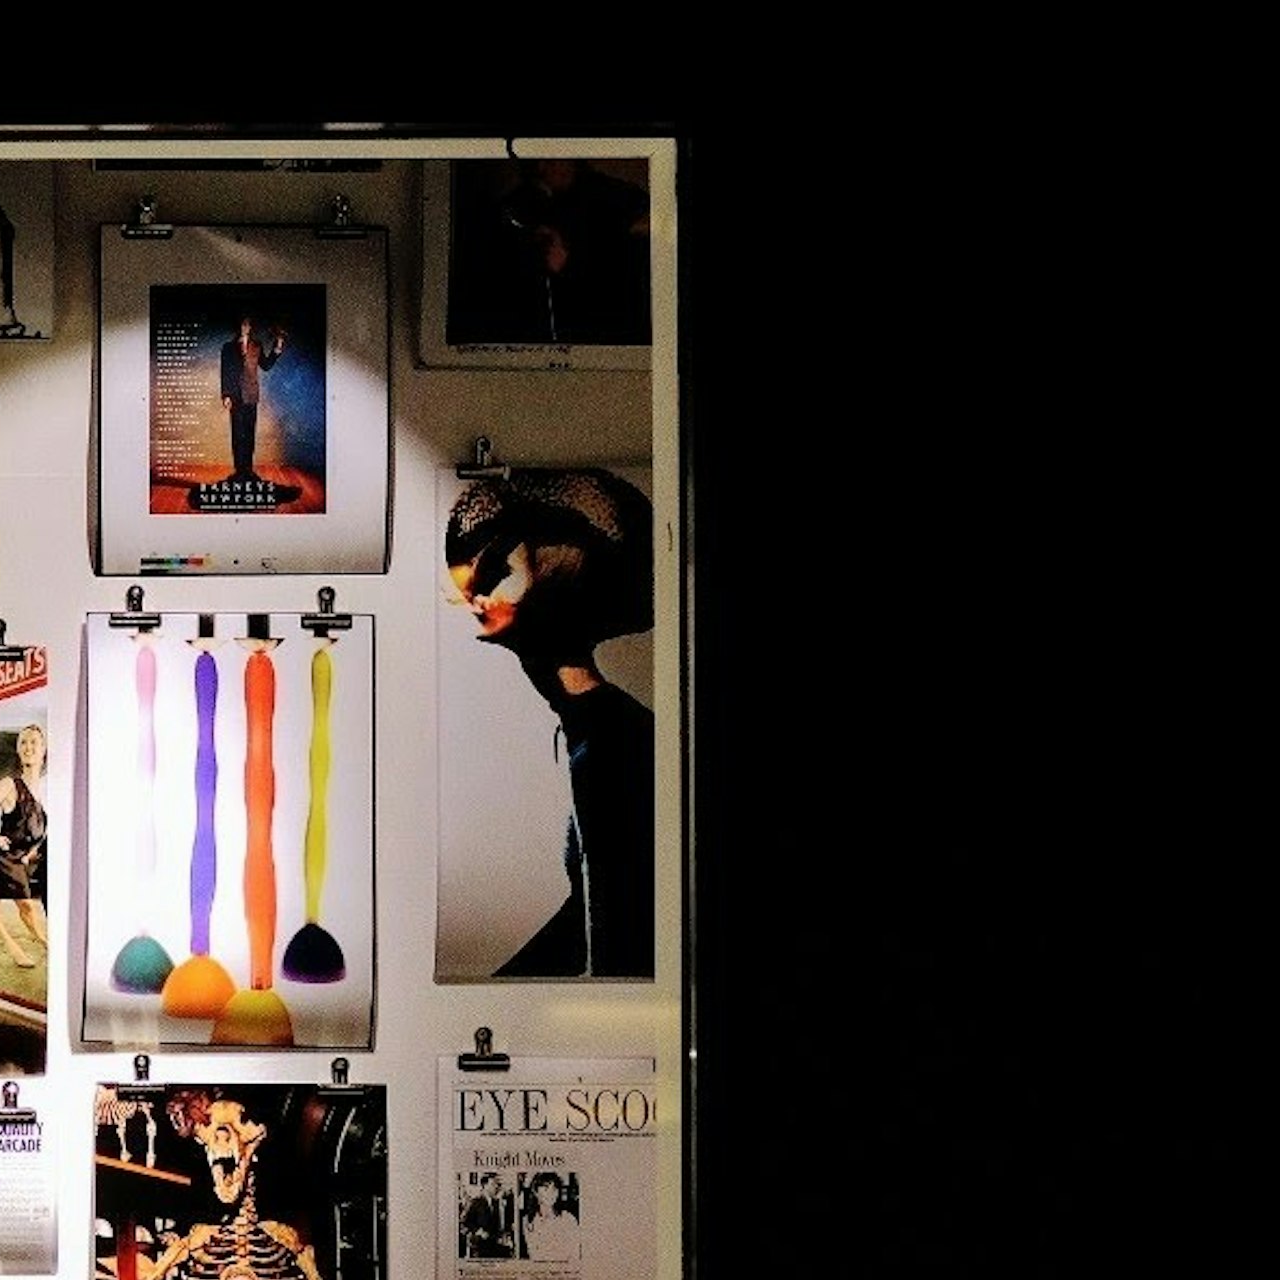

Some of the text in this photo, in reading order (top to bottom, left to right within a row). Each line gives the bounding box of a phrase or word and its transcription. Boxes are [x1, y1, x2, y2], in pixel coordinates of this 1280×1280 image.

[455, 1089, 657, 1131] EYE SCO
[474, 1151, 566, 1168] Knight Moves
